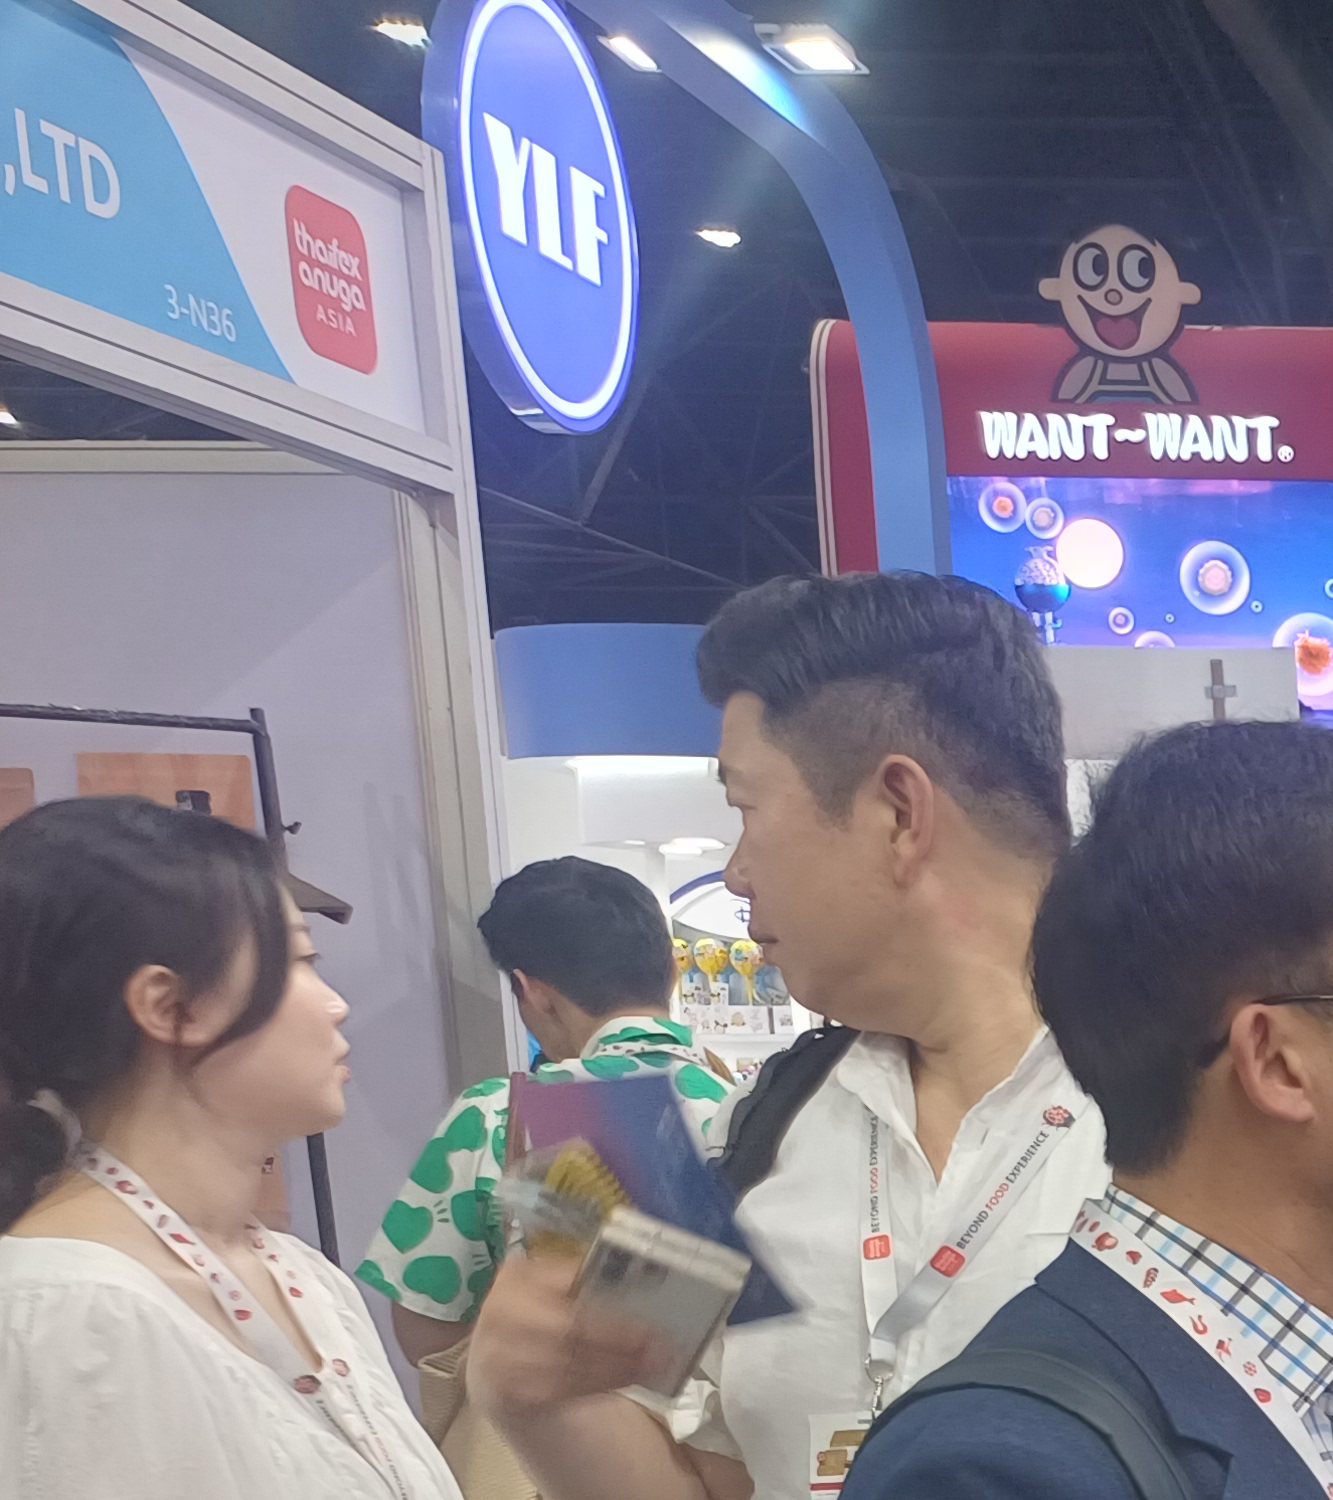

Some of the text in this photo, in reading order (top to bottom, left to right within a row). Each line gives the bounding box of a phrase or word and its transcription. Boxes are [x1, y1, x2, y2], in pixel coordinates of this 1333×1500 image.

[483, 111, 608, 288] YLF
[293, 217, 363, 282] thaifex
[163, 284, 238, 342] 3-N36
[299, 261, 366, 312] anuga
[316, 303, 357, 337] ASIA
[956, 1130, 1050, 1250] BEYOND FOOD EXPERIENCE
